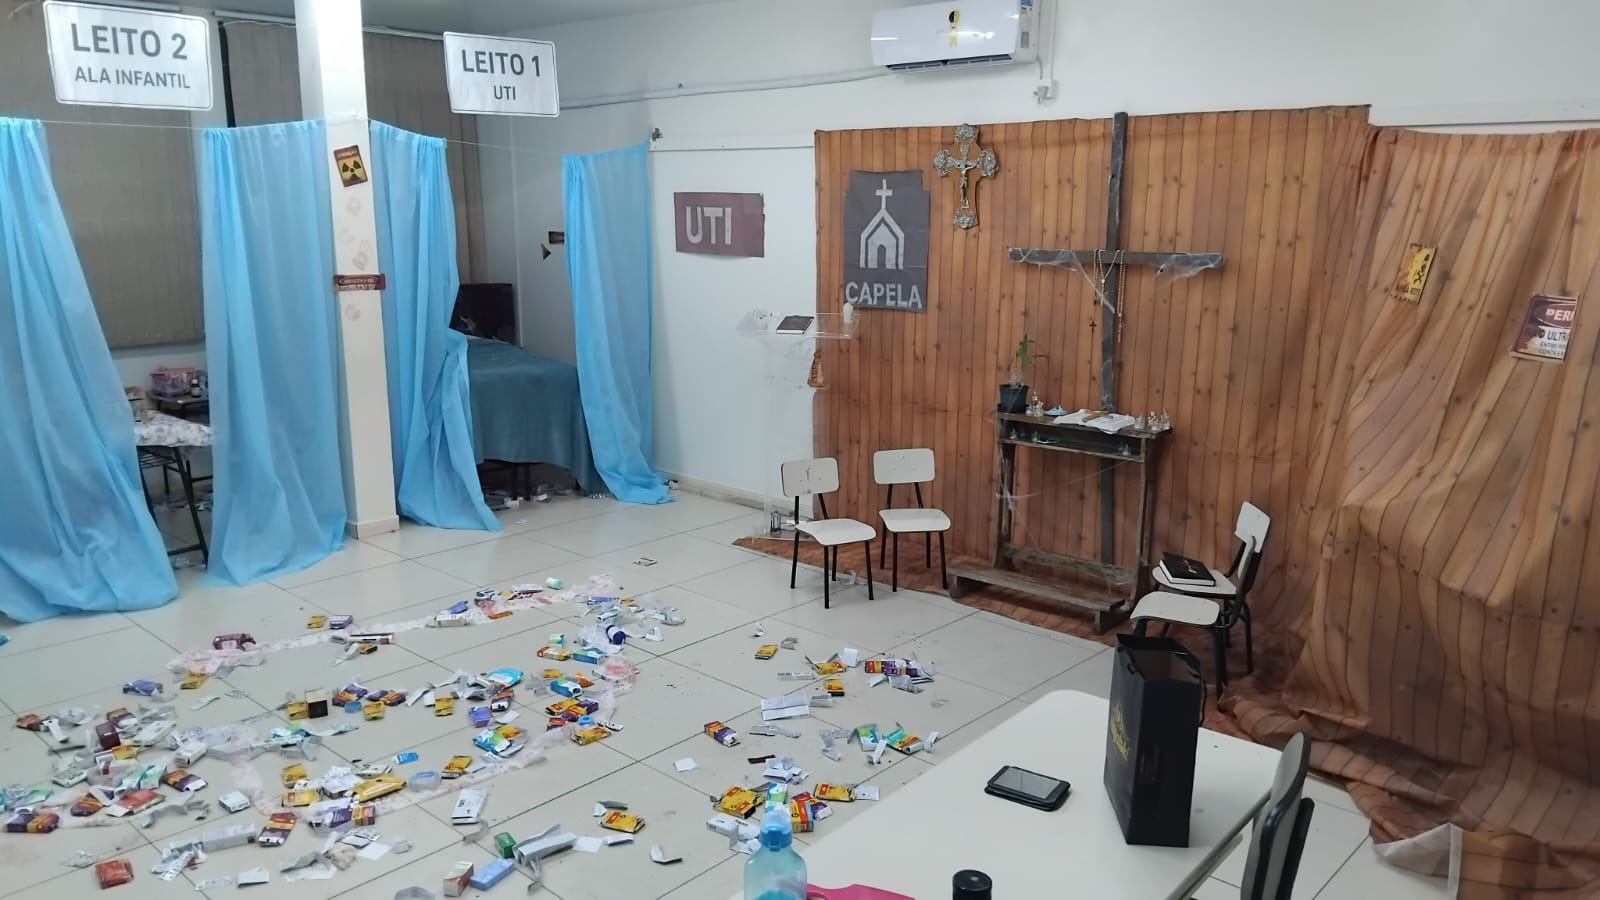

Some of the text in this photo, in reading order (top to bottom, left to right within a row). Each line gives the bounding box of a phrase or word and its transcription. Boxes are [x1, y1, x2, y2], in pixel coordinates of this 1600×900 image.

[71, 22, 187, 60] LEITO 2
[461, 49, 540, 77] LEITO 1
[75, 66, 191, 89] ALA INFANTIL
[493, 85, 516, 101] UTI
[685, 206, 732, 245] UTI
[845, 281, 923, 309] CAPELA
